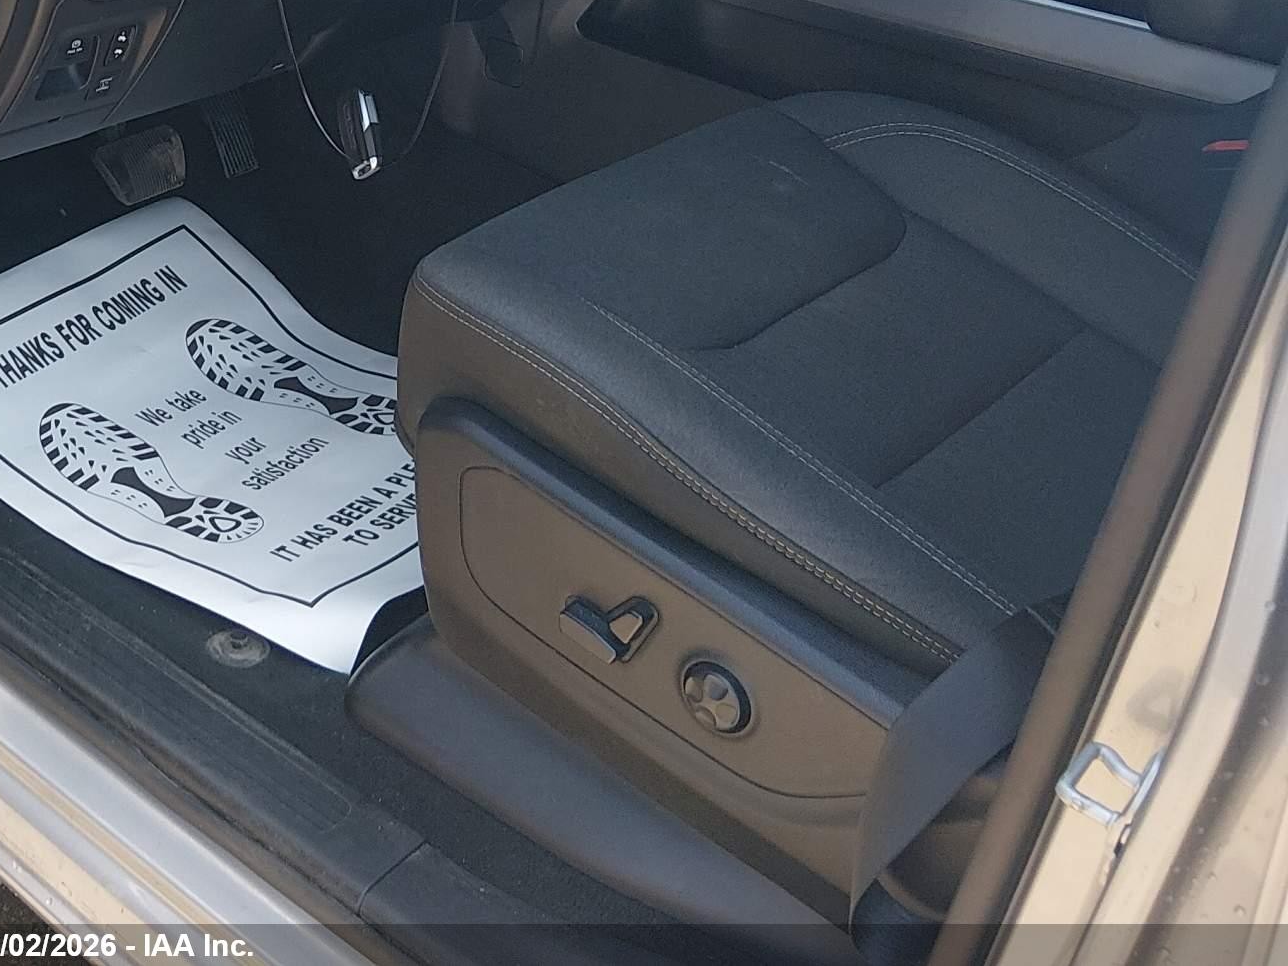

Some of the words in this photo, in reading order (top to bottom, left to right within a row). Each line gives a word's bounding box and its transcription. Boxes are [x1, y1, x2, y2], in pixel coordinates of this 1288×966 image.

[54, 313, 103, 351] FOR
[91, 278, 165, 331] COMING
[154, 265, 188, 294] IN
[135, 406, 173, 427] We
[165, 389, 207, 412] take
[181, 419, 226, 450] pride
[212, 410, 242, 425] in
[224, 437, 267, 465] your
[241, 436, 330, 490] satisfaction
[384, 459, 416, 488] PLE
[372, 486, 399, 499] A
[326, 495, 384, 527] BEEN
[290, 523, 338, 550] HAS
[342, 529, 380, 546] TO
[269, 544, 301, 562] IT
